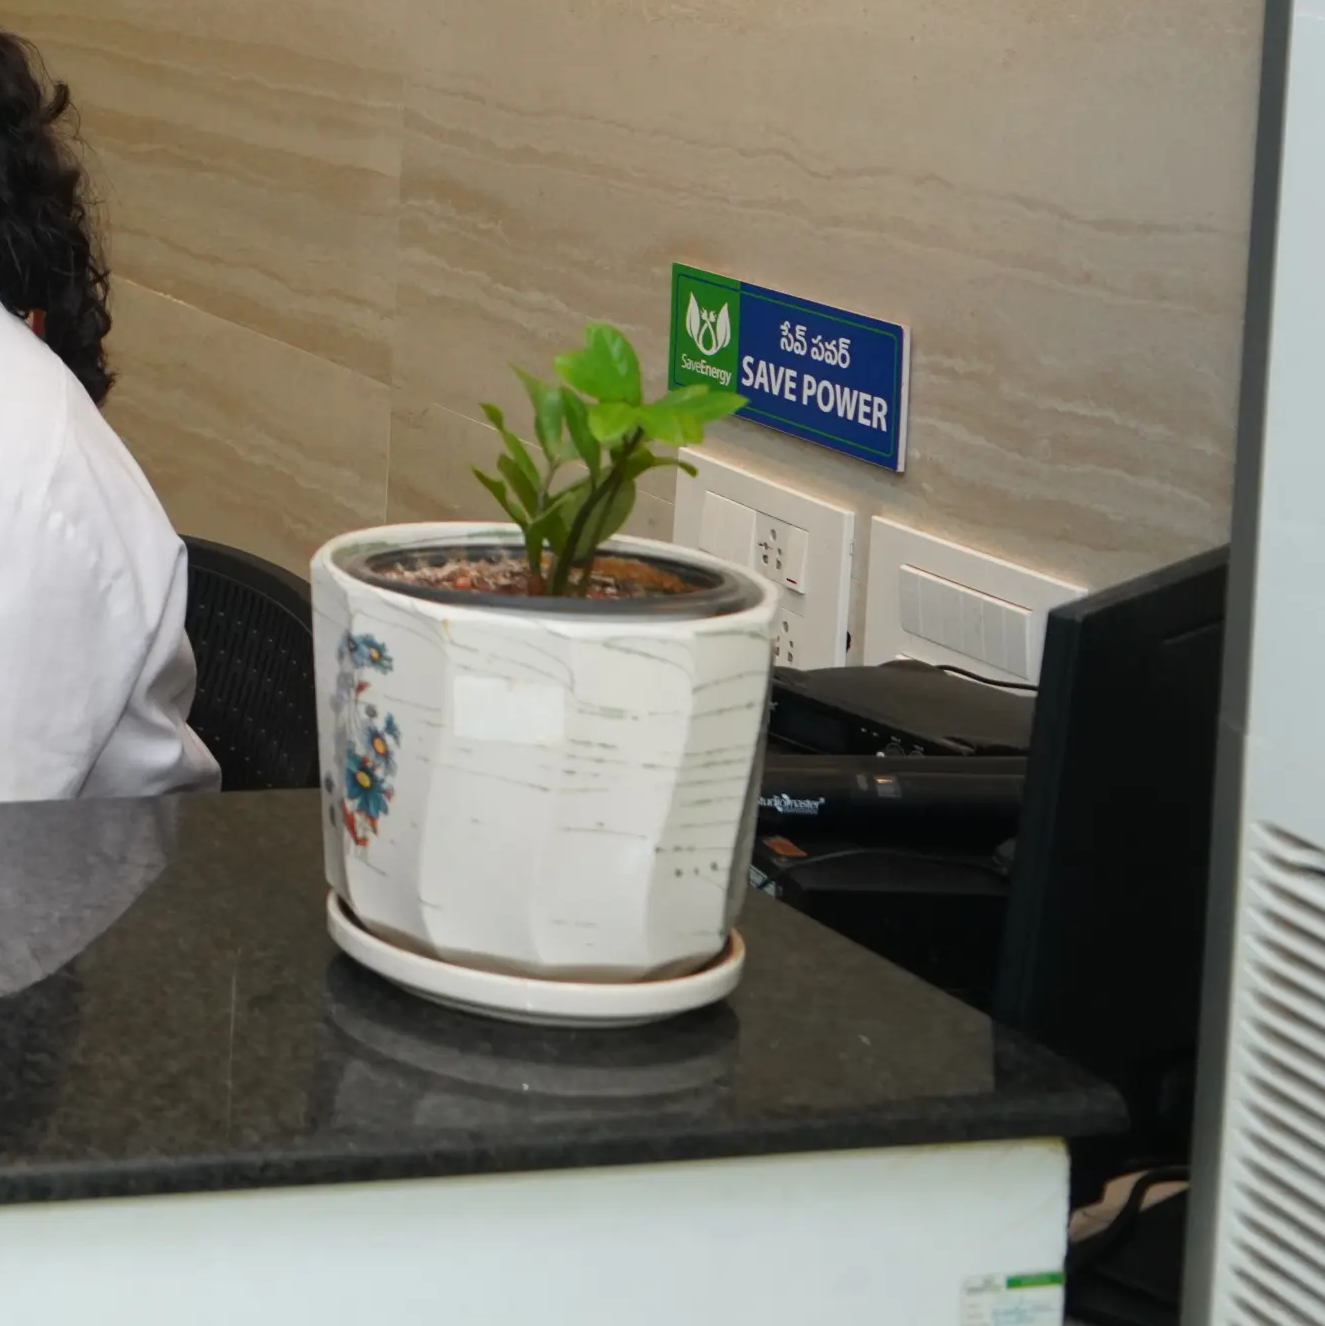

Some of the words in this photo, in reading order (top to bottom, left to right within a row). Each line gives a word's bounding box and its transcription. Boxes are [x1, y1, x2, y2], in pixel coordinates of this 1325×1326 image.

[681, 354, 732, 387] SaveEnergy
[741, 355, 798, 402] SAVE
[802, 373, 888, 433] POWER
